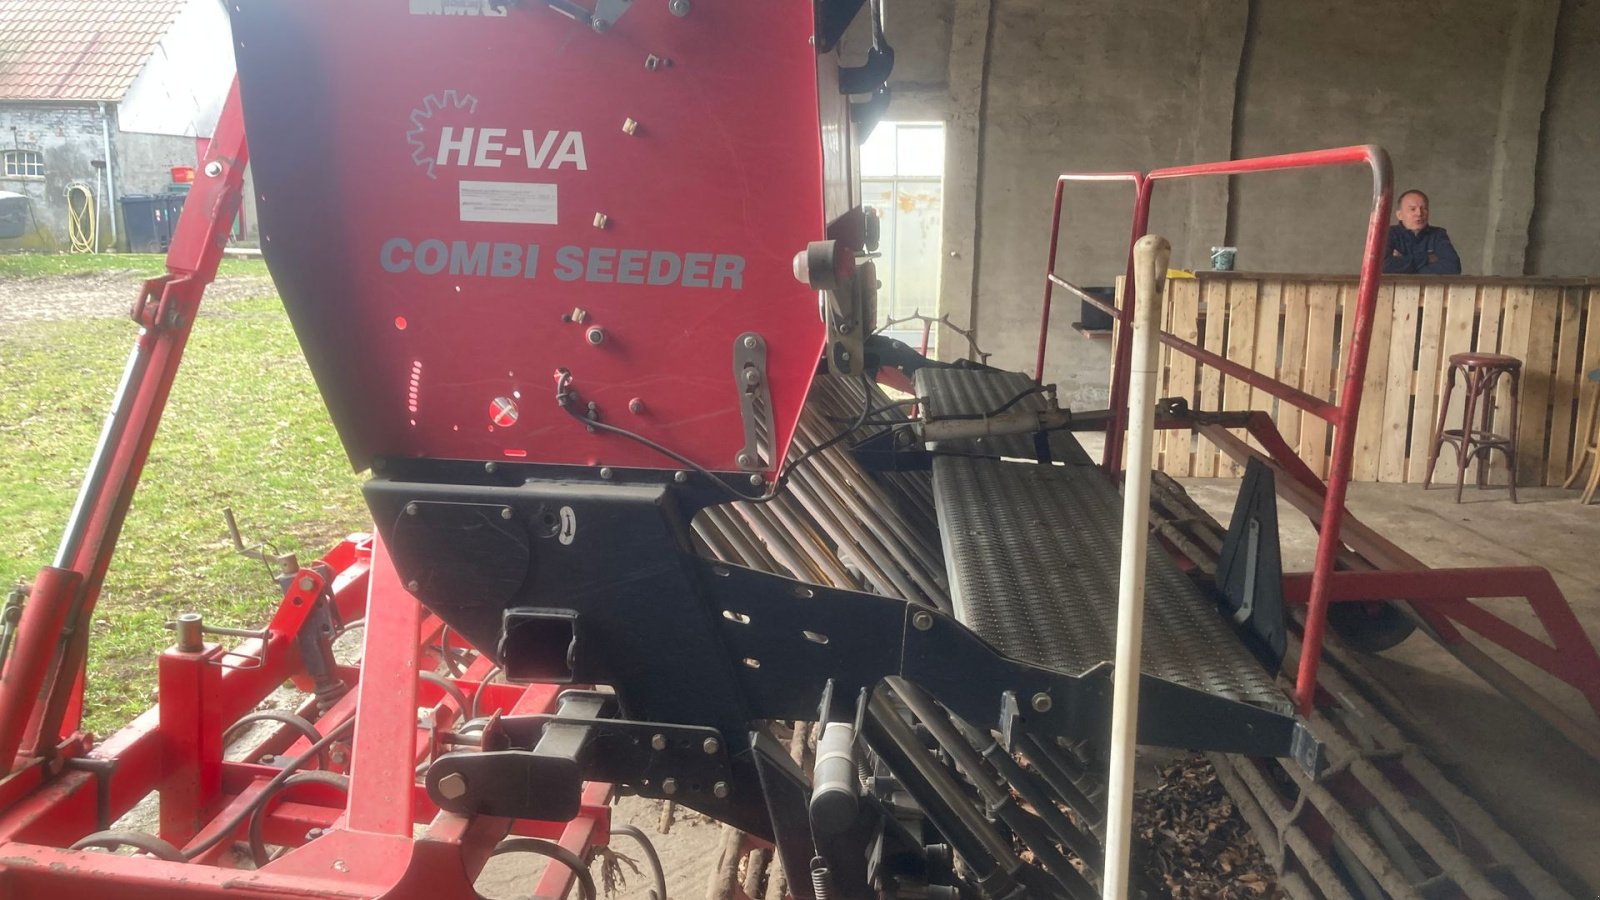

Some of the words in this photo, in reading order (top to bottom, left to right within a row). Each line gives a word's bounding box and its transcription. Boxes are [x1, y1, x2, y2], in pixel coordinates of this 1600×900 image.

[436, 127, 588, 170] HE-VA
[380, 238, 540, 279] COMBI
[553, 246, 746, 289] SEEDER
